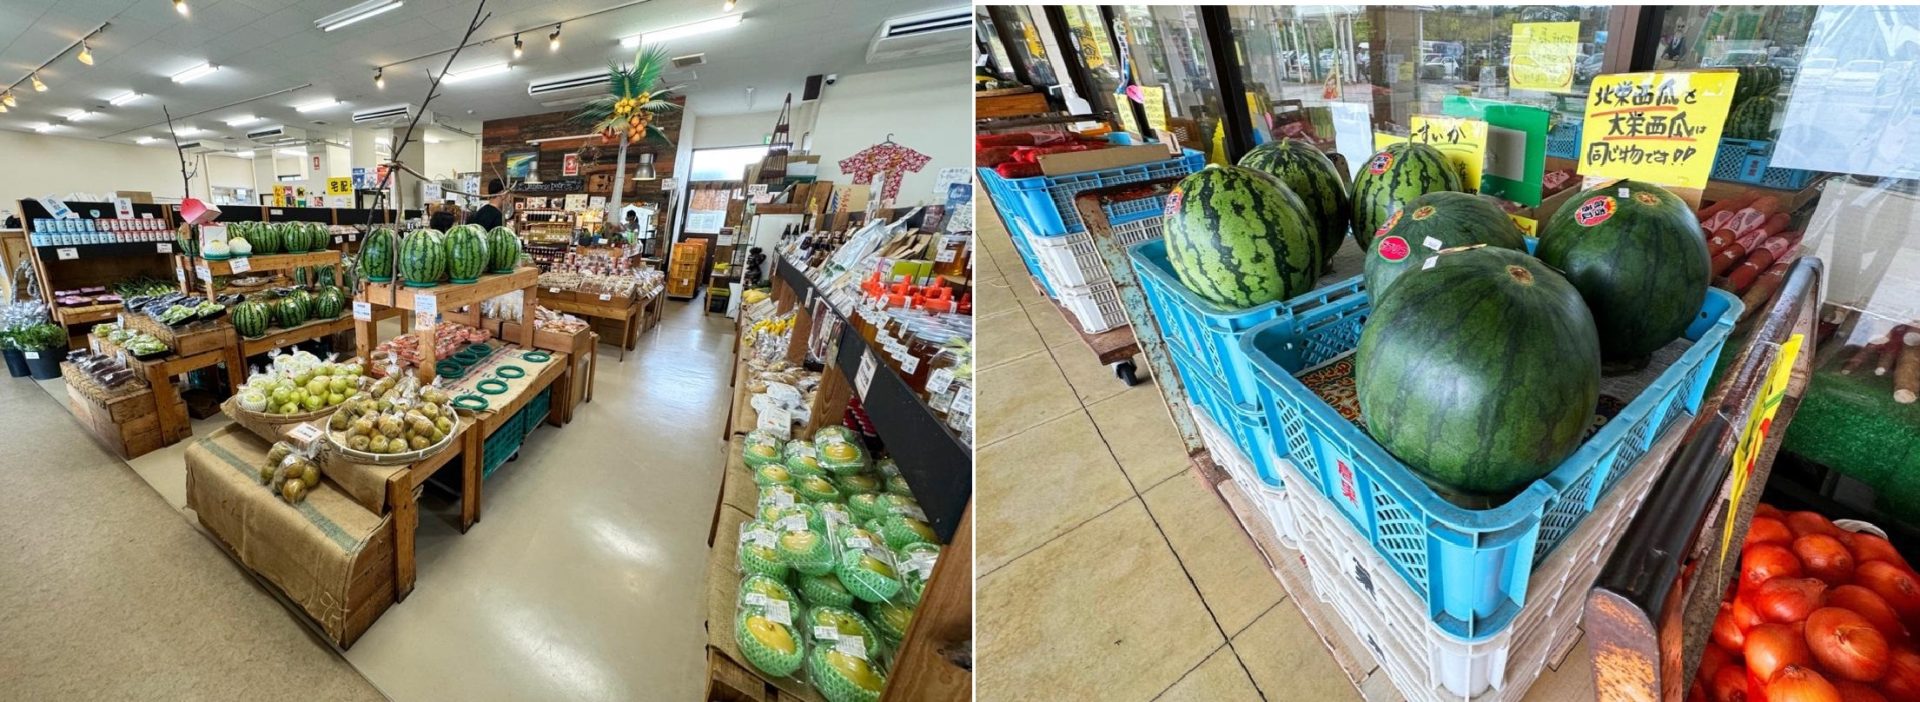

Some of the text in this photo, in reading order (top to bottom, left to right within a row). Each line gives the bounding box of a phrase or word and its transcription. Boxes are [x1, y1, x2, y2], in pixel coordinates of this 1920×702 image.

[1416, 120, 1467, 145] すいか
[1608, 111, 1707, 138] 大栄西瓜は
[331, 180, 353, 193] 宅配
